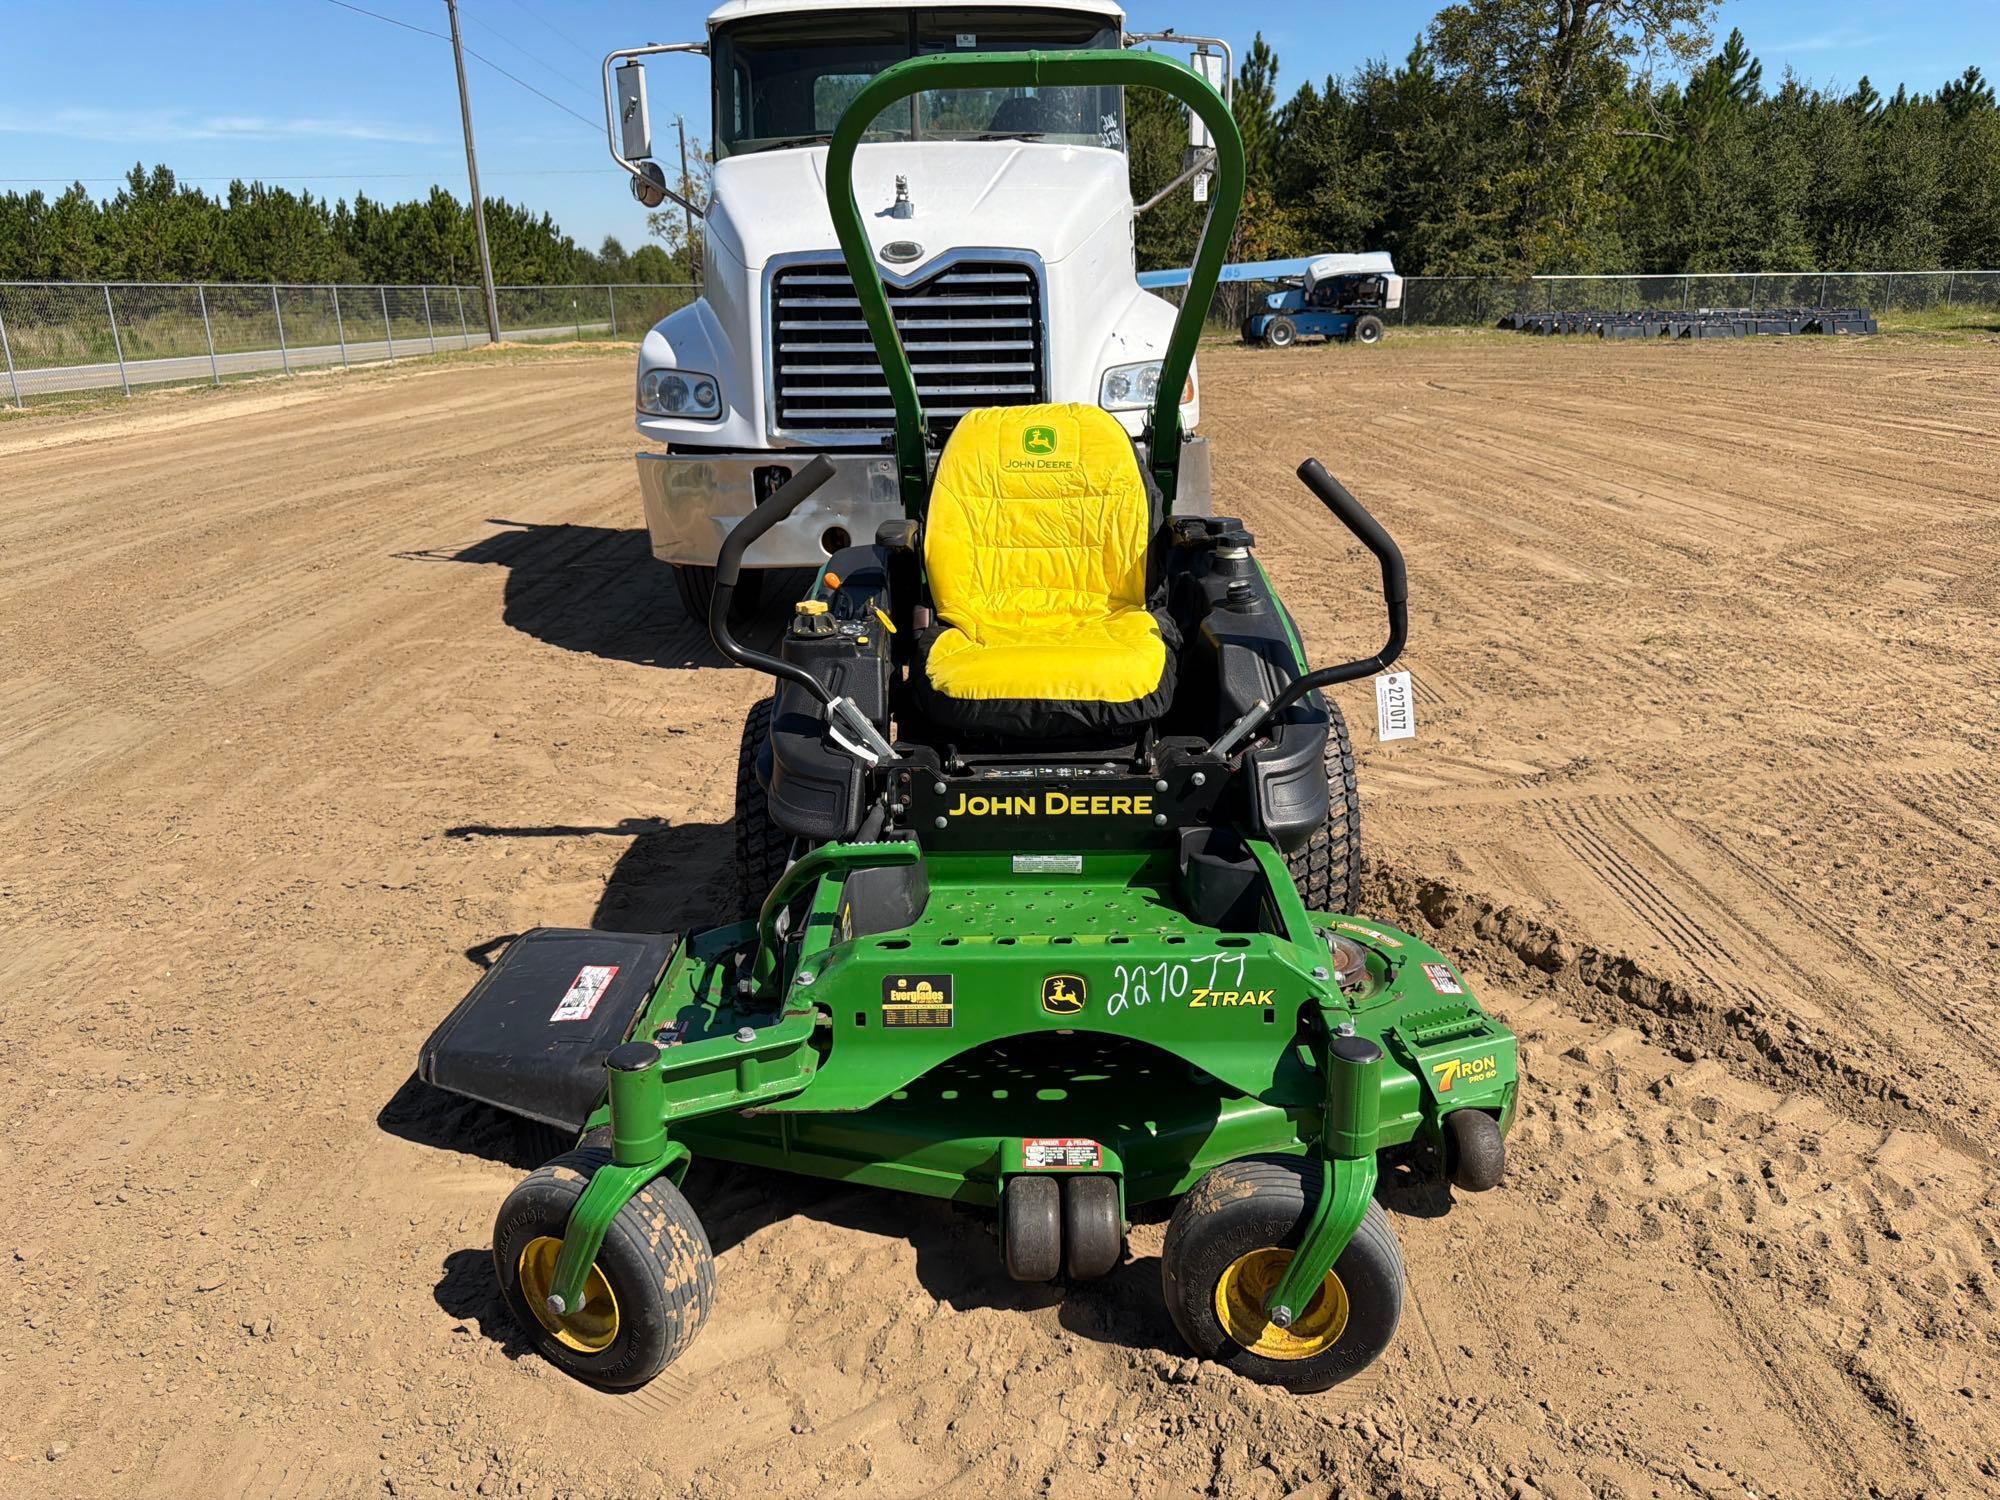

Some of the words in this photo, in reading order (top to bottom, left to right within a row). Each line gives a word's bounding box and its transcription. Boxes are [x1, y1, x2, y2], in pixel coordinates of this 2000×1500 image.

[1224, 267, 1241, 279] 85
[1005, 459, 1034, 468] JOHN
[1037, 459, 1072, 468] DEERE
[1389, 686, 1406, 729] 227077
[949, 793, 1036, 816] JOHN
[1045, 792, 1153, 815] DEERE
[890, 990, 944, 1003] Everglades
[1188, 988, 1276, 1008] ZTRAK
[1468, 1073, 1485, 1084] PRO
[1485, 1069, 1497, 1079] 60
